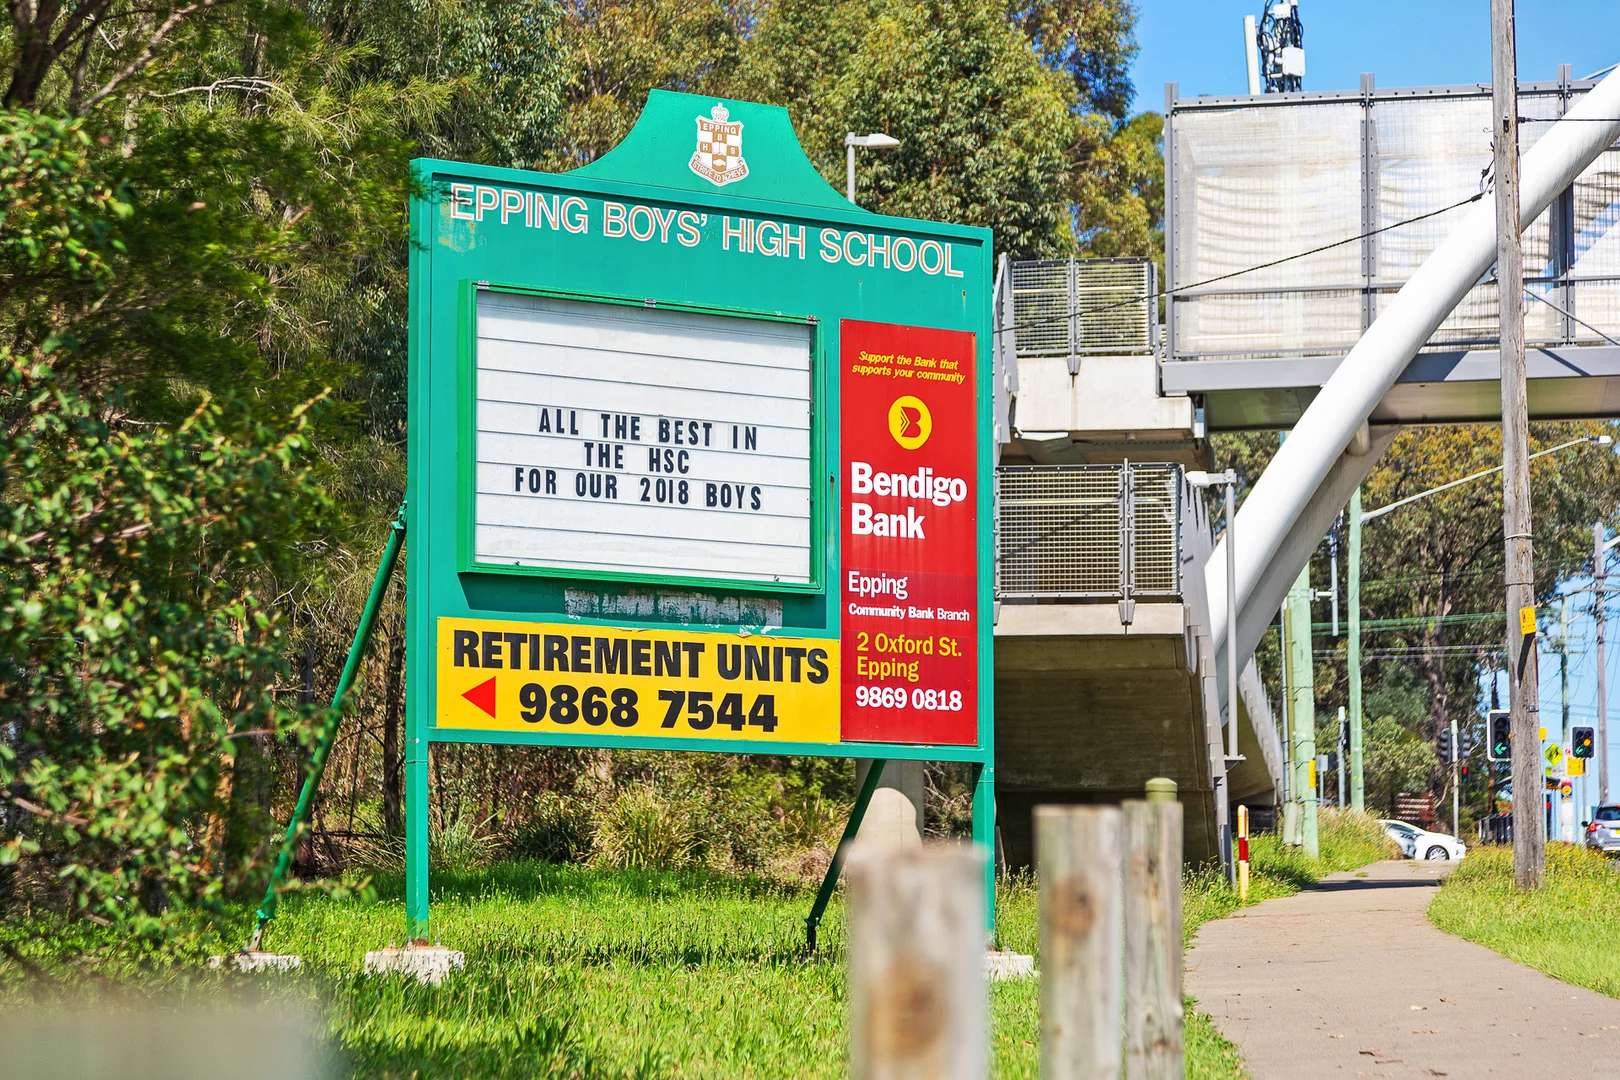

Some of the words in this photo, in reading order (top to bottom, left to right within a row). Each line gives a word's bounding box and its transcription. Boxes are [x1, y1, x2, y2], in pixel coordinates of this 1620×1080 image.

[702, 122, 736, 134] EPPING
[716, 134, 723, 142] B
[702, 144, 708, 152] H
[730, 146, 736, 154] S
[692, 162, 714, 178] STRIVE
[713, 174, 722, 182] TO
[450, 182, 588, 234] EPPING
[722, 216, 806, 260] HIGH
[820, 228, 964, 278] SCHOOL
[858, 350, 894, 364] Support
[896, 355, 912, 366] the
[914, 356, 937, 368] Bank
[940, 359, 958, 370] that
[852, 364, 892, 376] supports
[893, 368, 914, 378] your
[916, 370, 966, 384] community
[538, 408, 579, 436] ALL
[601, 414, 640, 441] THE
[658, 418, 712, 446] BEST
[732, 425, 756, 450] IN
[584, 442, 624, 469] THE
[649, 448, 690, 474] HSC
[515, 467, 556, 494] FOR
[576, 472, 617, 499] OUR
[640, 477, 689, 504] 2018
[706, 483, 762, 510] BOYS
[851, 462, 968, 506] Bendigo
[852, 502, 926, 540] Bank
[848, 570, 908, 600] Epping
[848, 603, 906, 620] Community
[908, 606, 934, 620] Bank
[937, 608, 970, 622] Branch
[453, 629, 704, 679] RETIREMENT
[717, 644, 829, 684] UNITS
[856, 632, 869, 651] 2
[875, 633, 934, 655] Oxford
[938, 636, 962, 656] St.
[857, 656, 920, 682] Epping
[519, 683, 639, 728] 9868
[658, 689, 778, 732] 7544
[856, 686, 908, 708] 9869
[912, 688, 962, 711] 0818
